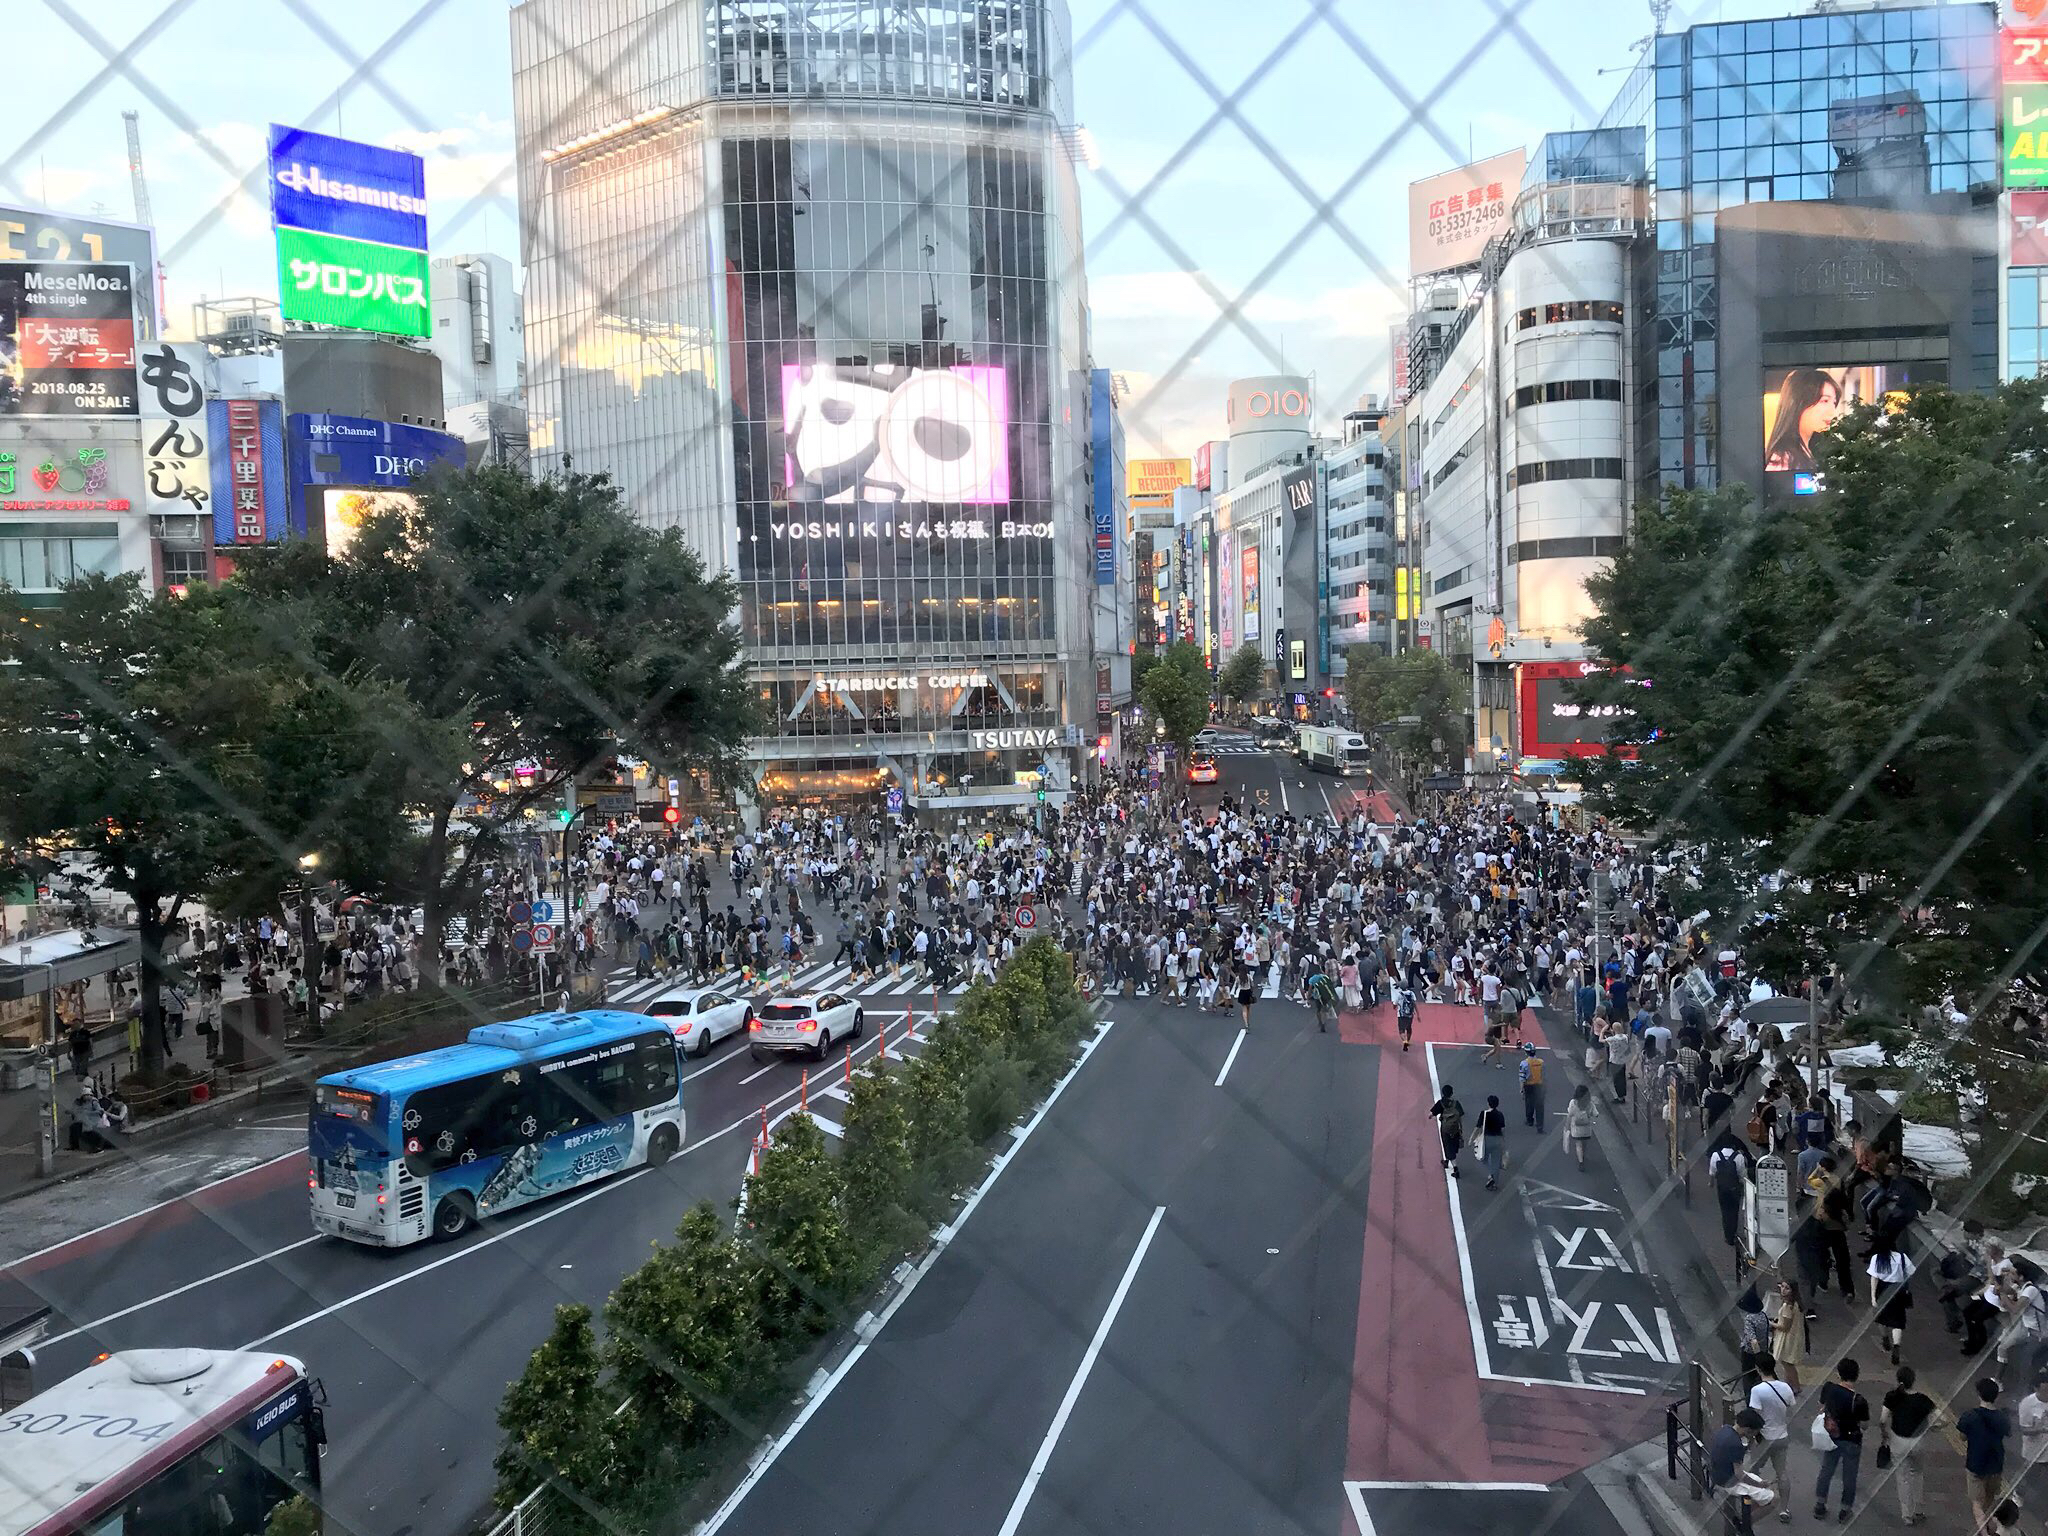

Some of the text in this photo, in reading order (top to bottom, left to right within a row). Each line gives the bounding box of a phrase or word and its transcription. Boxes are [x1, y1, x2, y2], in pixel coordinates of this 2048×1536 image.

[2014, 38, 2048, 65] ア
[2013, 97, 2048, 126] レ
[277, 163, 426, 216] Hisamitsu
[1429, 182, 1504, 220] 広告募集
[1428, 201, 1505, 238] 03-5337-2468
[25, 272, 128, 291] MeseMoa.
[290, 259, 427, 308] サロンパス
[25, 293, 88, 307] 4th single
[24, 321, 99, 346] 「大逆転
[32, 382, 106, 395] 2018.08.25
[75, 396, 131, 409] ON SALE
[141, 344, 209, 511] もんじゃ
[310, 424, 377, 437] DHC Channel
[0, 453, 16, 462] OR
[374, 455, 424, 478] DHC
[1142, 462, 1177, 476] TOWER
[233, 405, 262, 538] 三千里薬品
[1138, 477, 1183, 492] RECORDS
[1096, 513, 1112, 572] SEIBU
[816, 674, 988, 692] STARBUCKS COFFEE
[972, 729, 1059, 749] TSUTAYA
[540, 1061, 567, 1075] SHIBUYA
[567, 1053, 598, 1068] community
[599, 1050, 610, 1059] bus
[256, 1394, 297, 1431] KEIO BUS
